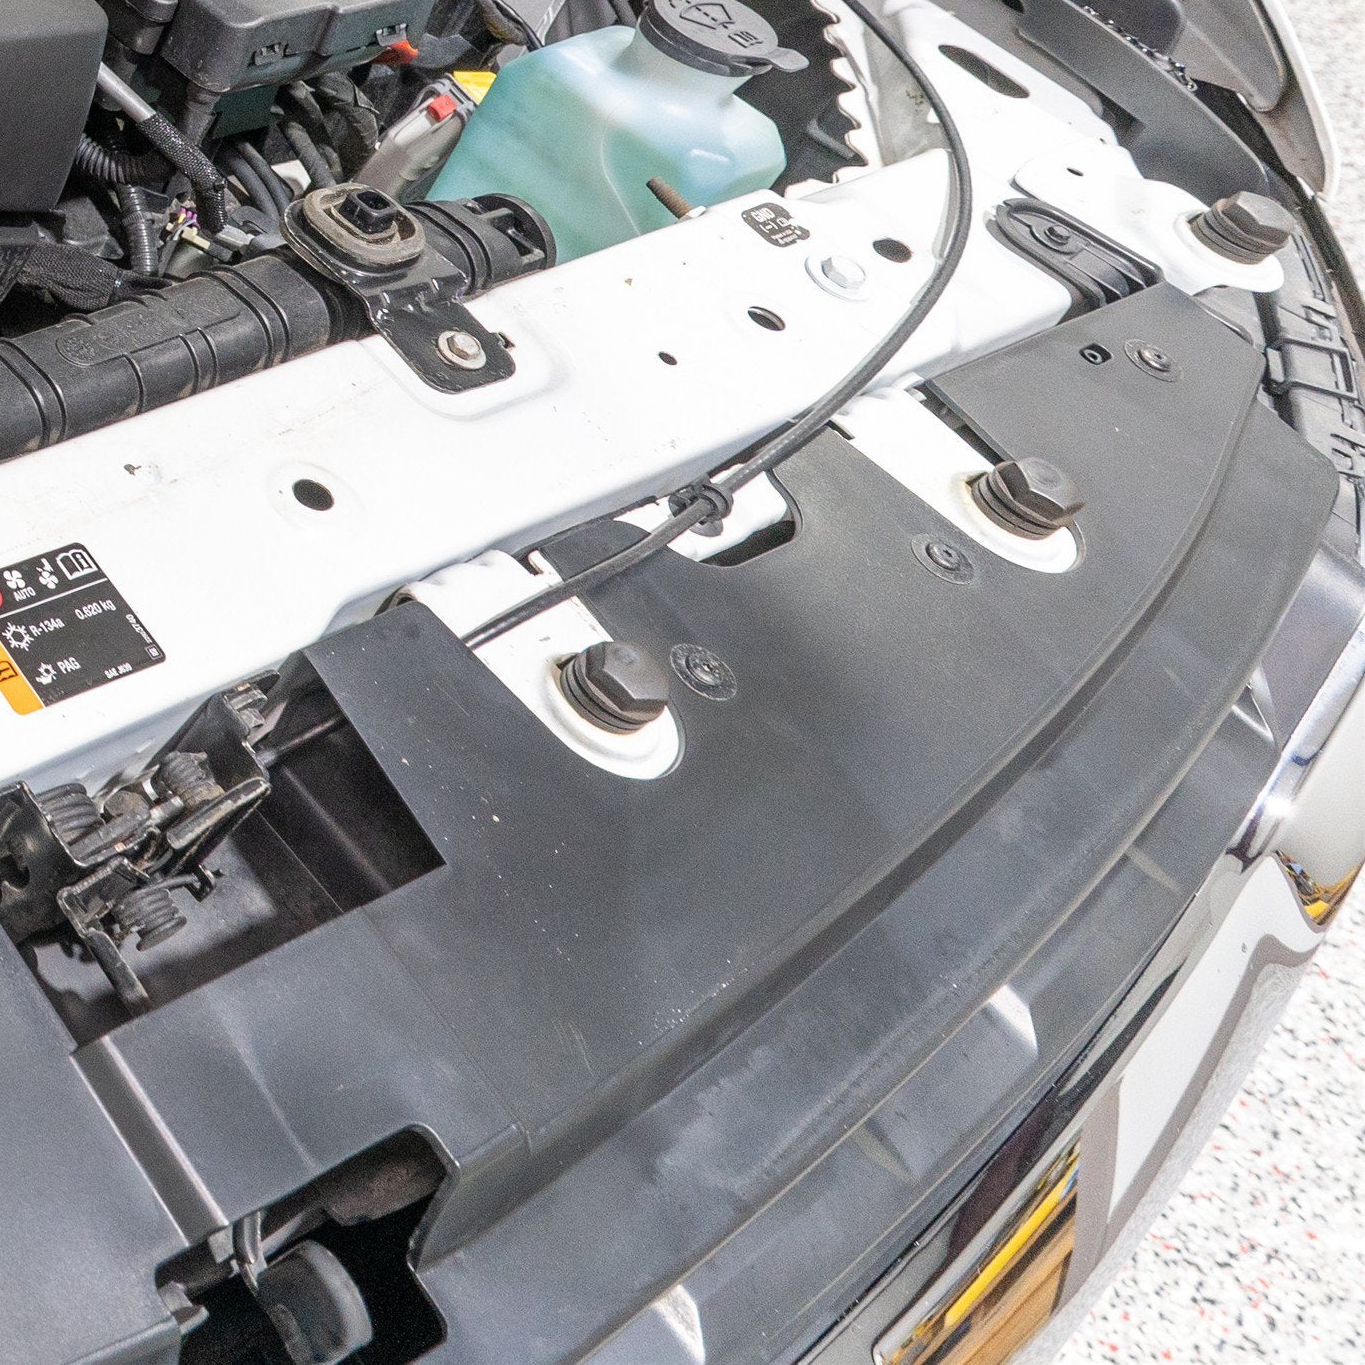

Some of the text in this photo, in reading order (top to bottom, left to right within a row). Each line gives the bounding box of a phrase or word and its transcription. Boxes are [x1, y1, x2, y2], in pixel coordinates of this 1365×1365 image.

[750, 207, 776, 223] GND
[13, 586, 36, 602] AUTO
[29, 599, 117, 637] R-134a 0.620 kg
[57, 656, 81, 674] PAG
